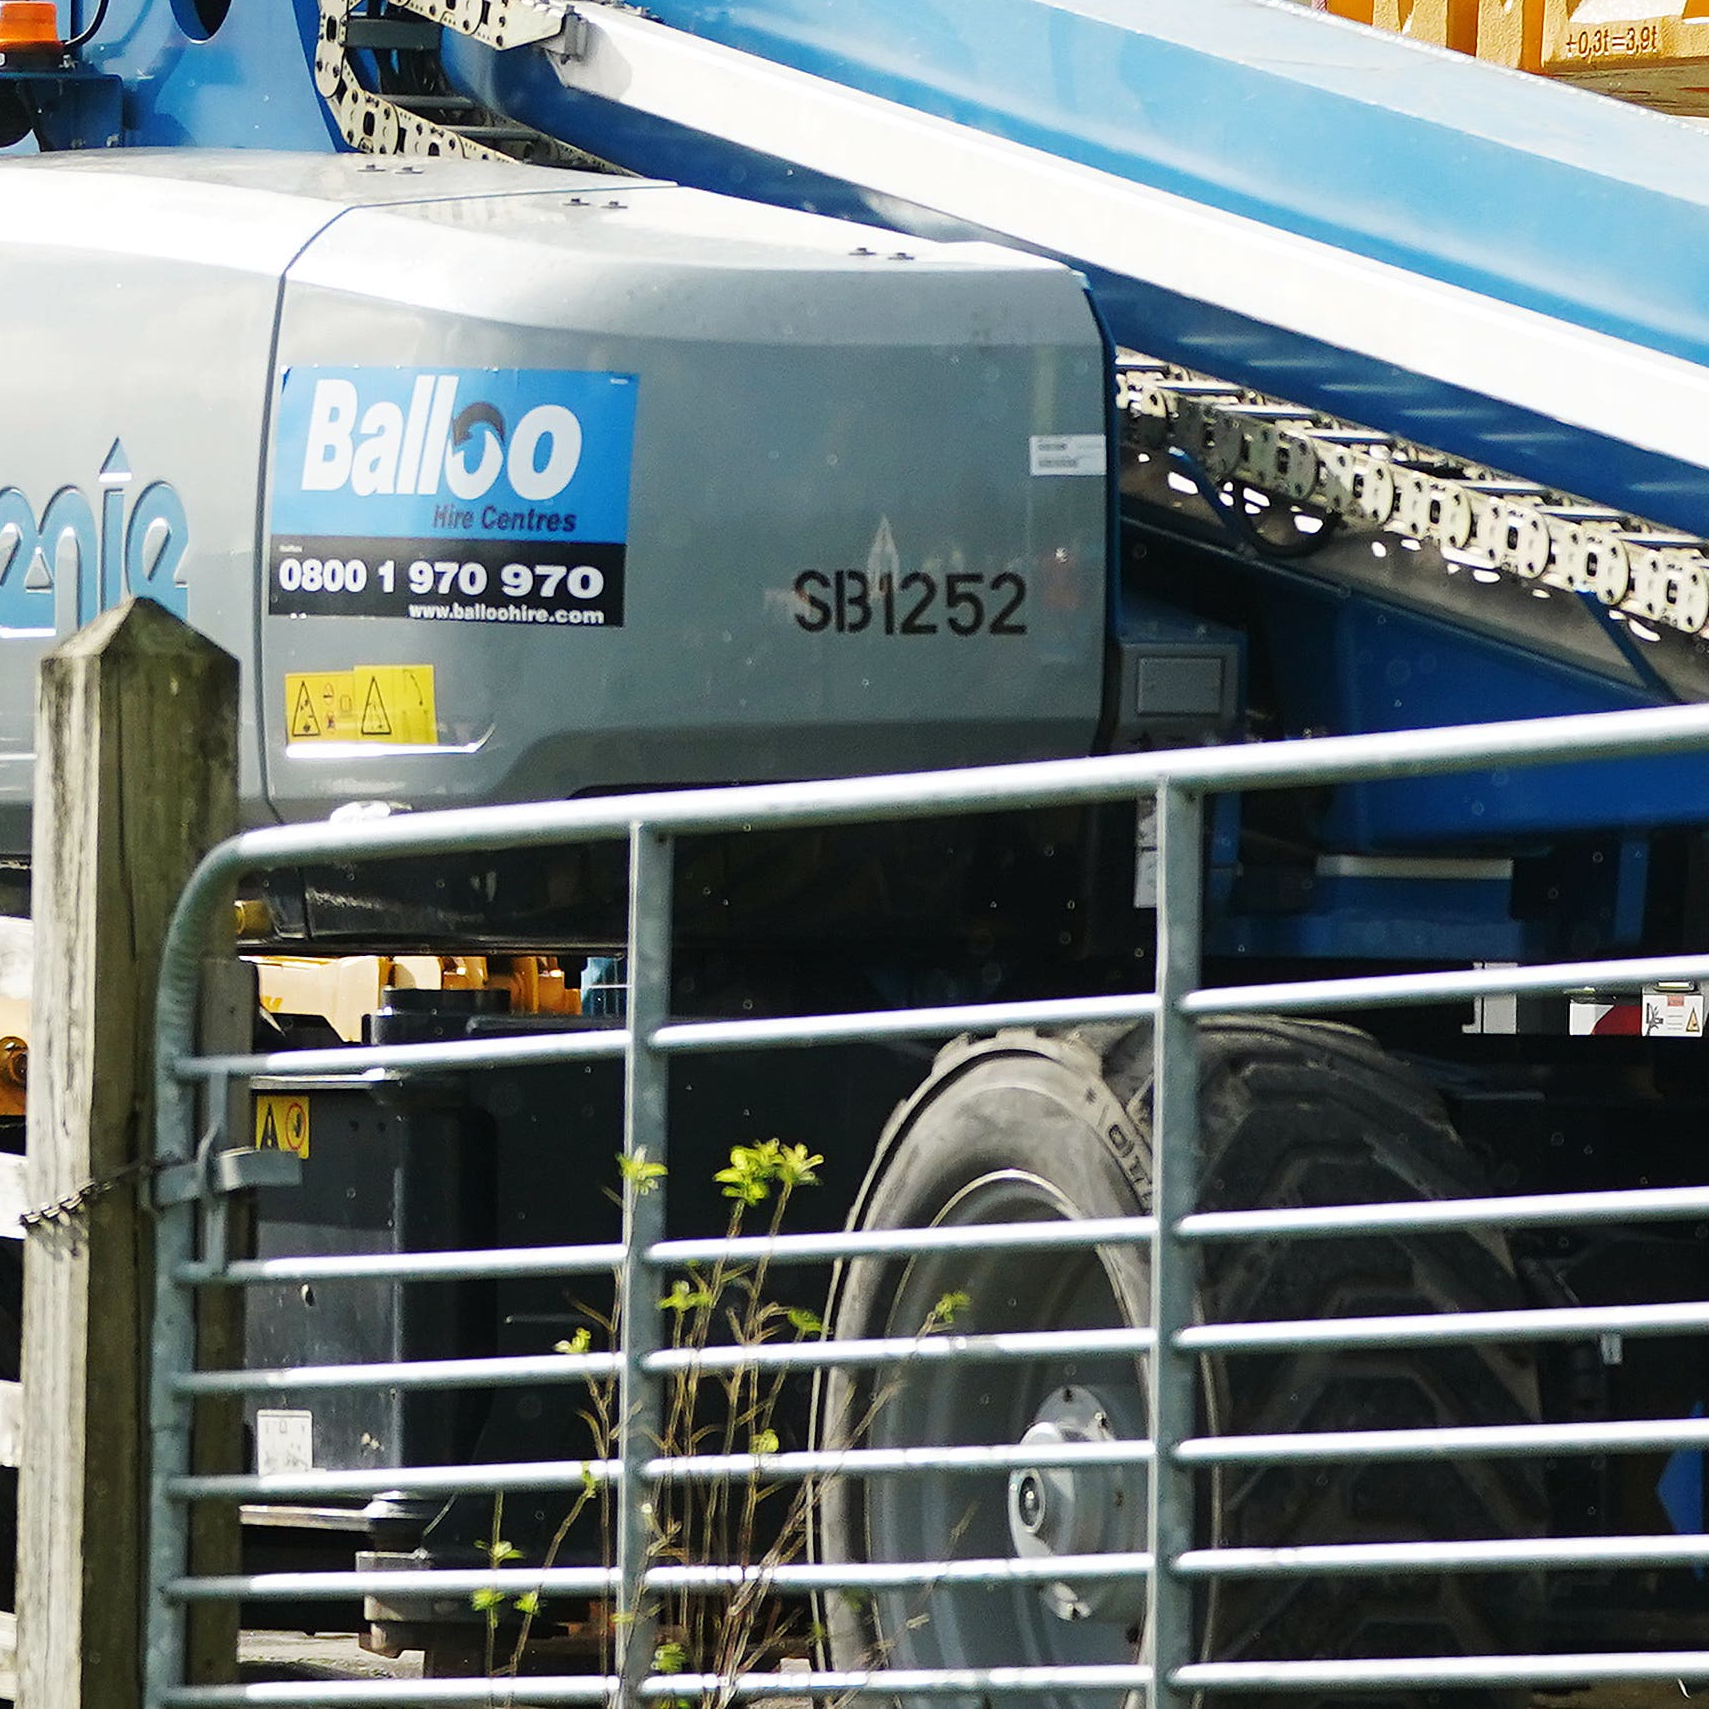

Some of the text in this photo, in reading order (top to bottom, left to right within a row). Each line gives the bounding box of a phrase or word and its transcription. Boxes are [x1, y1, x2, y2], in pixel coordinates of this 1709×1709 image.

[301, 374, 583, 501] Balloo
[432, 504, 577, 534] Hire Centres
[278, 557, 605, 599] 0800 1 970 970
[407, 601, 605, 625] www.balloohire.com
[792, 567, 1029, 637] SB1252
